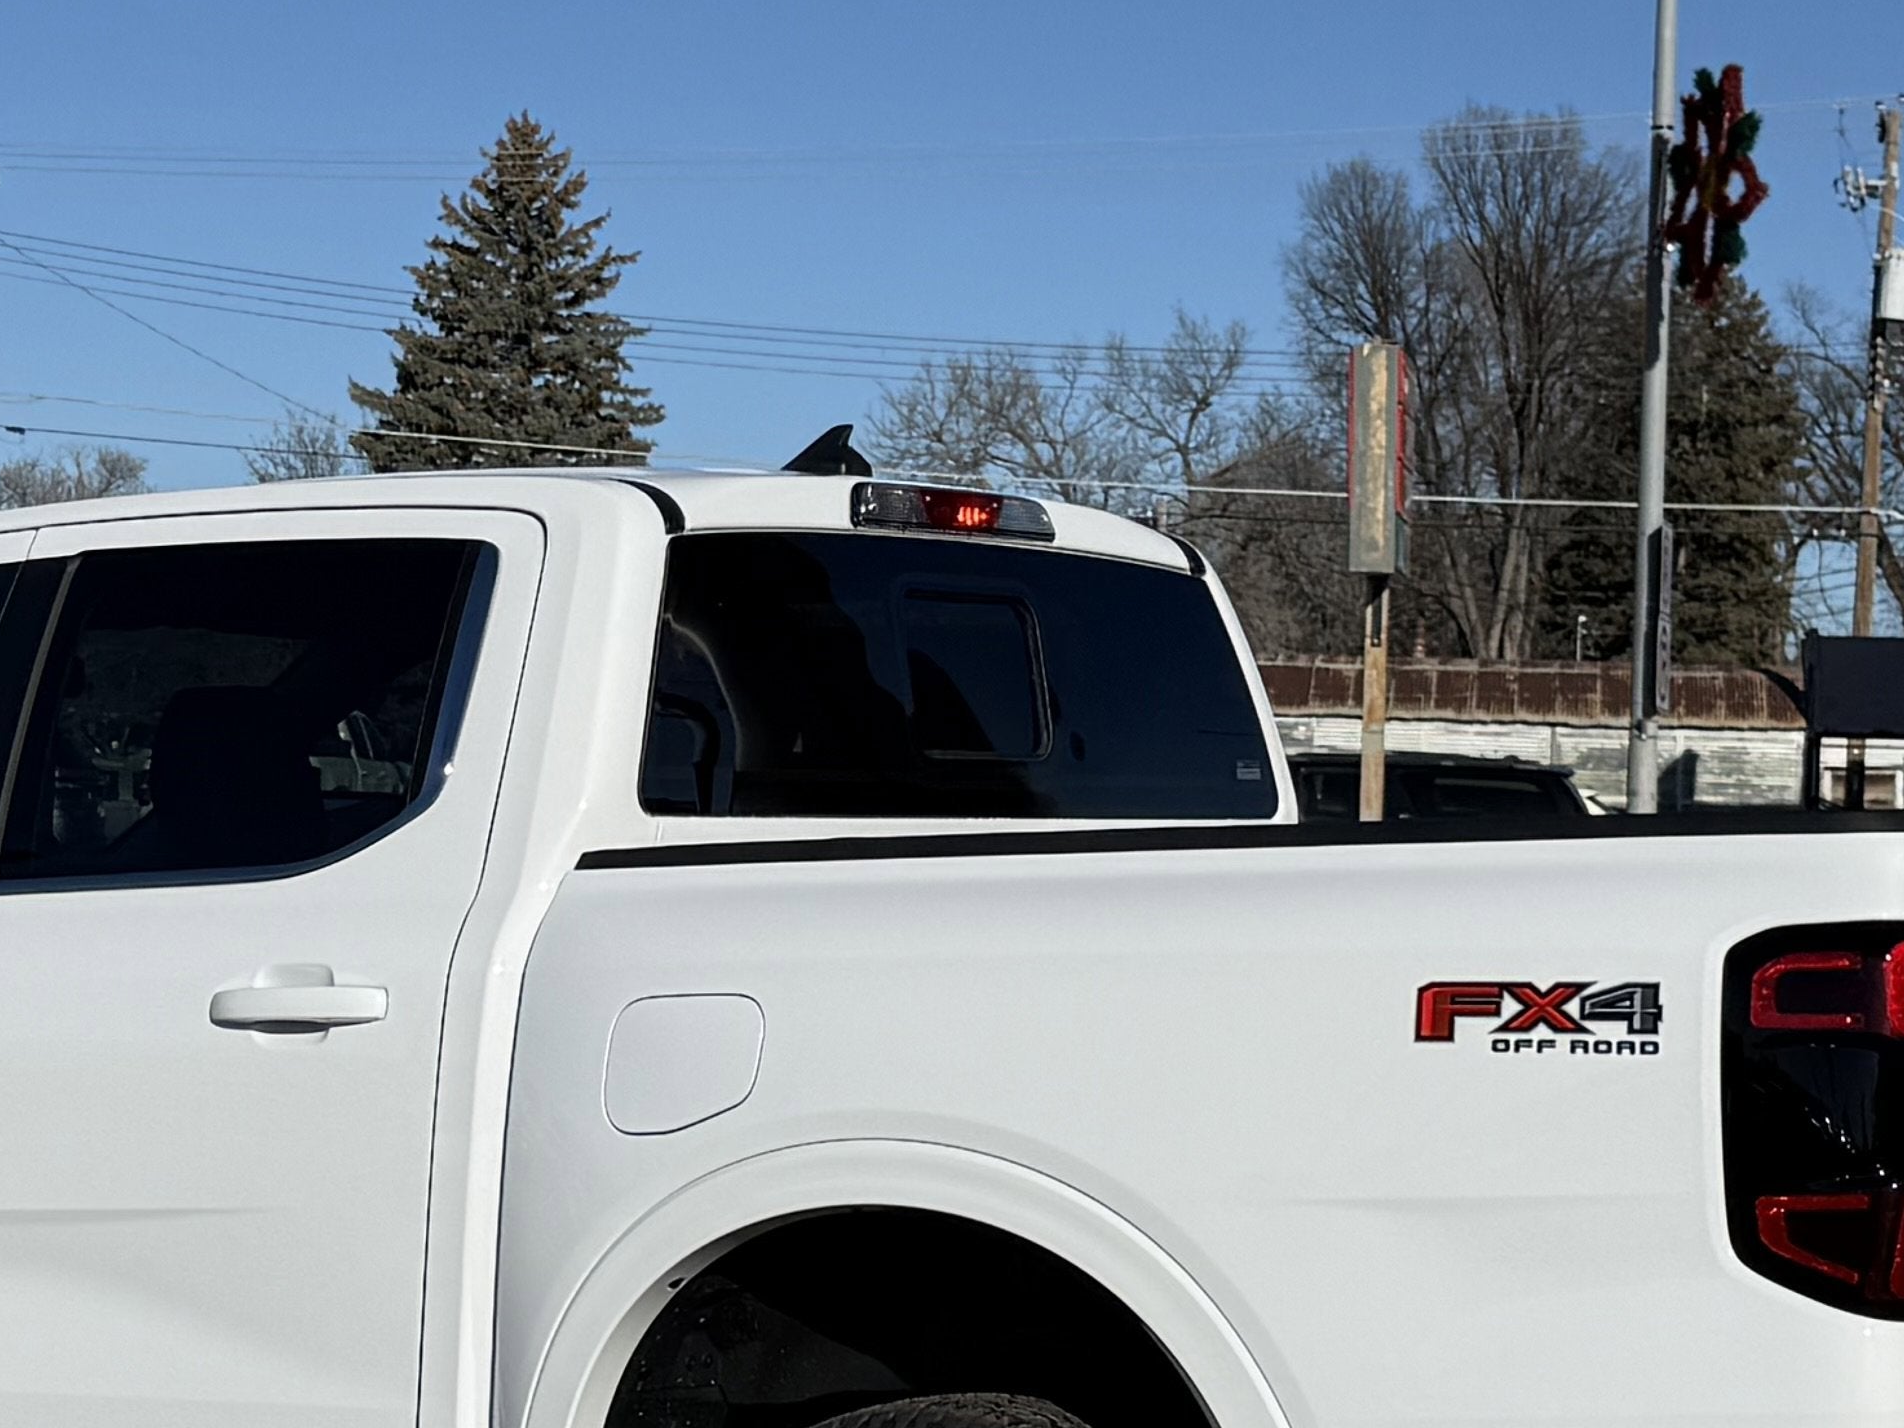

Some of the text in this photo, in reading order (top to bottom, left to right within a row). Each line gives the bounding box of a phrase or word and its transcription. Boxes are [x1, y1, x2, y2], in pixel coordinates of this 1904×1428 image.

[1414, 981, 1663, 1042] FX4
[1491, 1039, 1660, 1055] OFF ROAD
